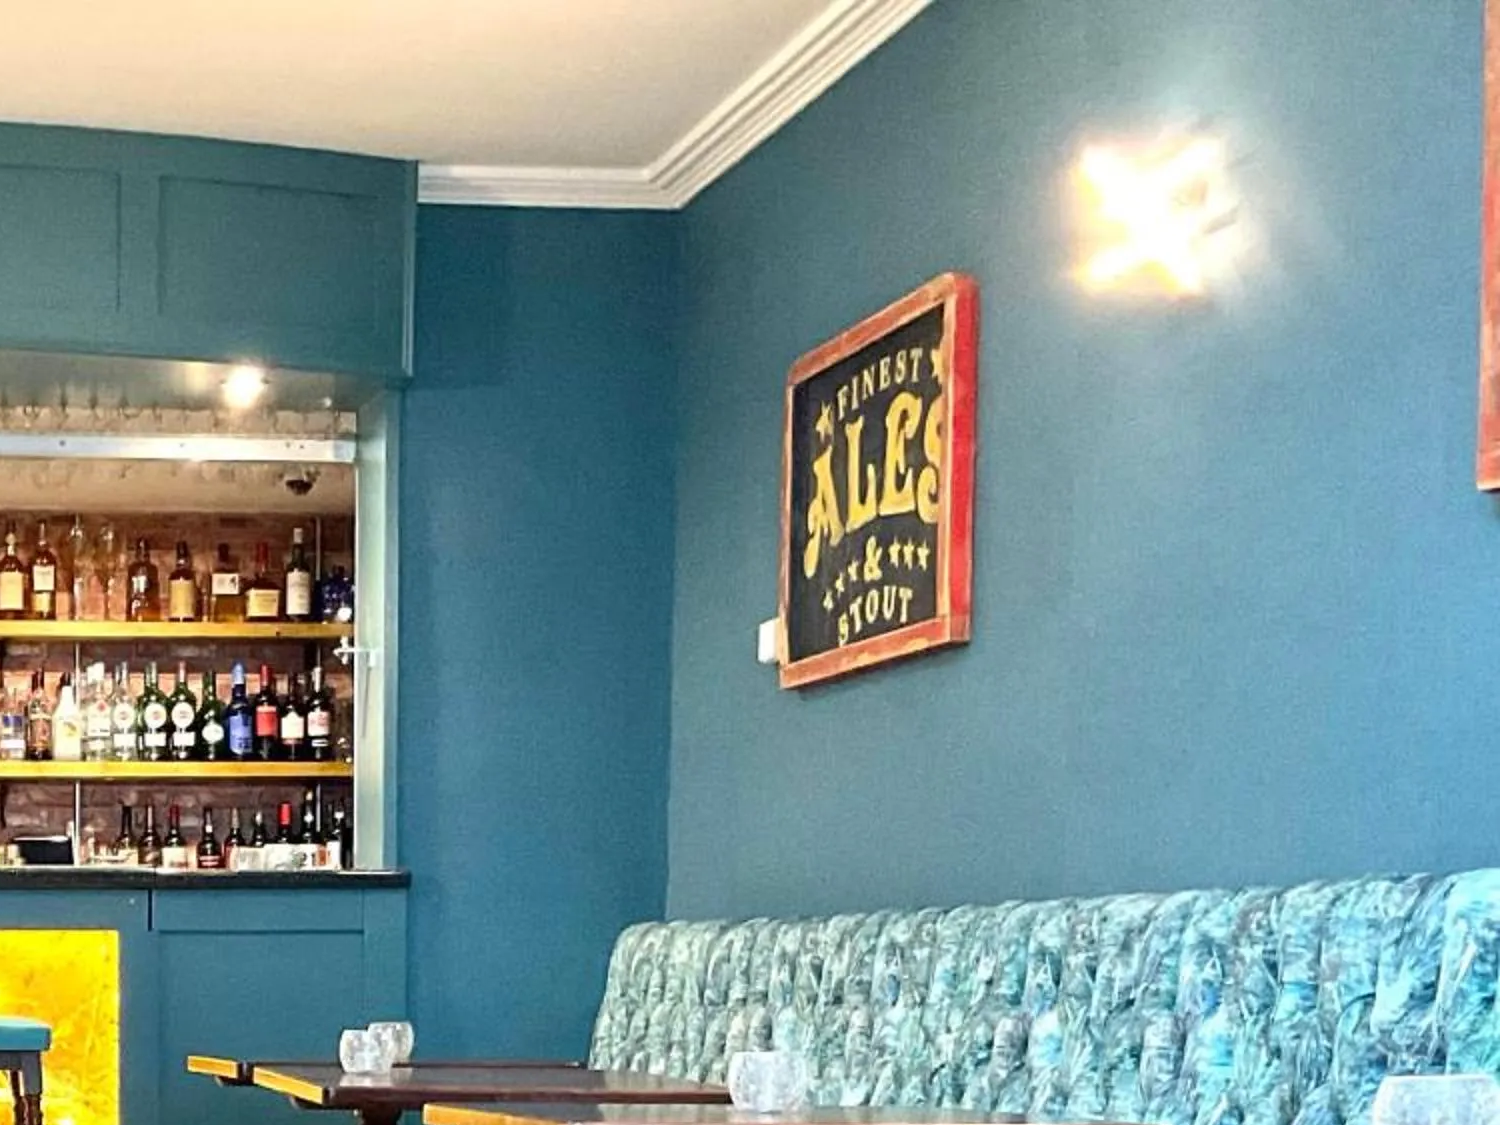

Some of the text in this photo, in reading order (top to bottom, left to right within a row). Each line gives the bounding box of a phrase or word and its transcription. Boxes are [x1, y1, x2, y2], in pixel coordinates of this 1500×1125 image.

[837, 346, 924, 421] FINEST
[803, 390, 947, 579] ALES
[863, 535, 882, 582] &
[837, 584, 913, 647] STOUT
